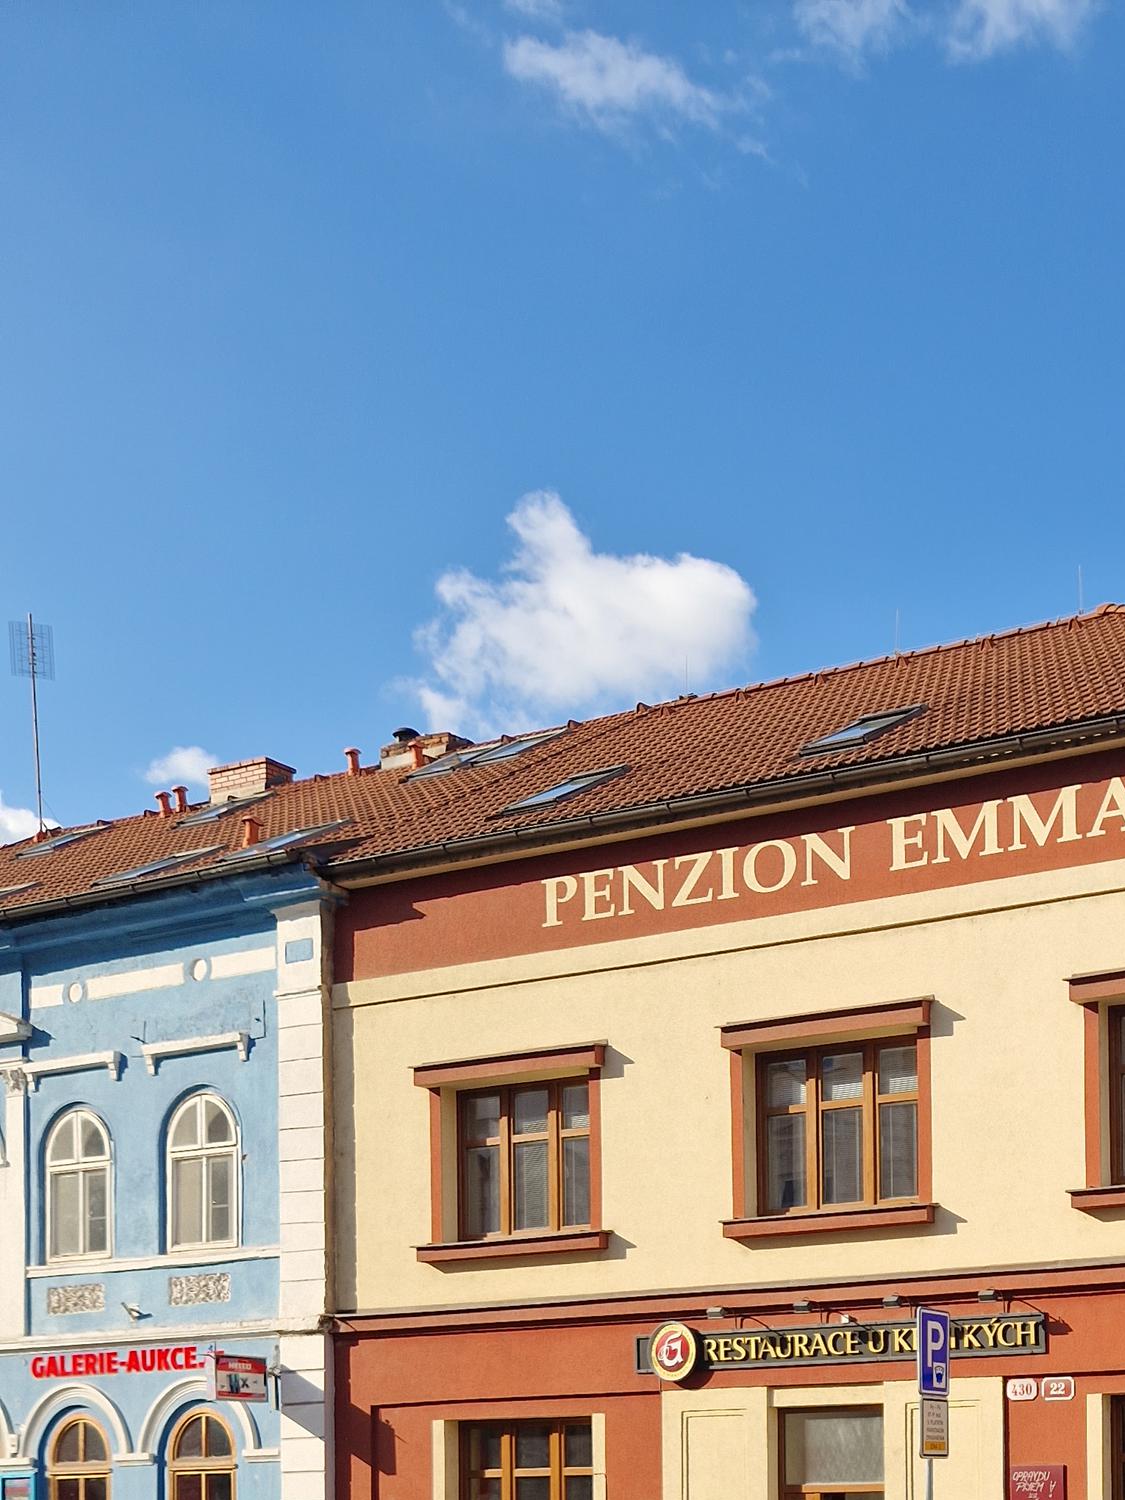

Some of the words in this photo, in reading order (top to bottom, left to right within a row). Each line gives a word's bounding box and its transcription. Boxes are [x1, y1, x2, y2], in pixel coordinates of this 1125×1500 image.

[541, 826, 856, 928] PENZION
[704, 1330, 860, 1362] RESTAURACE
[868, 1329, 886, 1353] U
[893, 1317, 1036, 1352] KKÝCH
[926, 1320, 945, 1368] P
[1011, 1383, 1033, 1397] 430
[1049, 1382, 1065, 1396] 22
